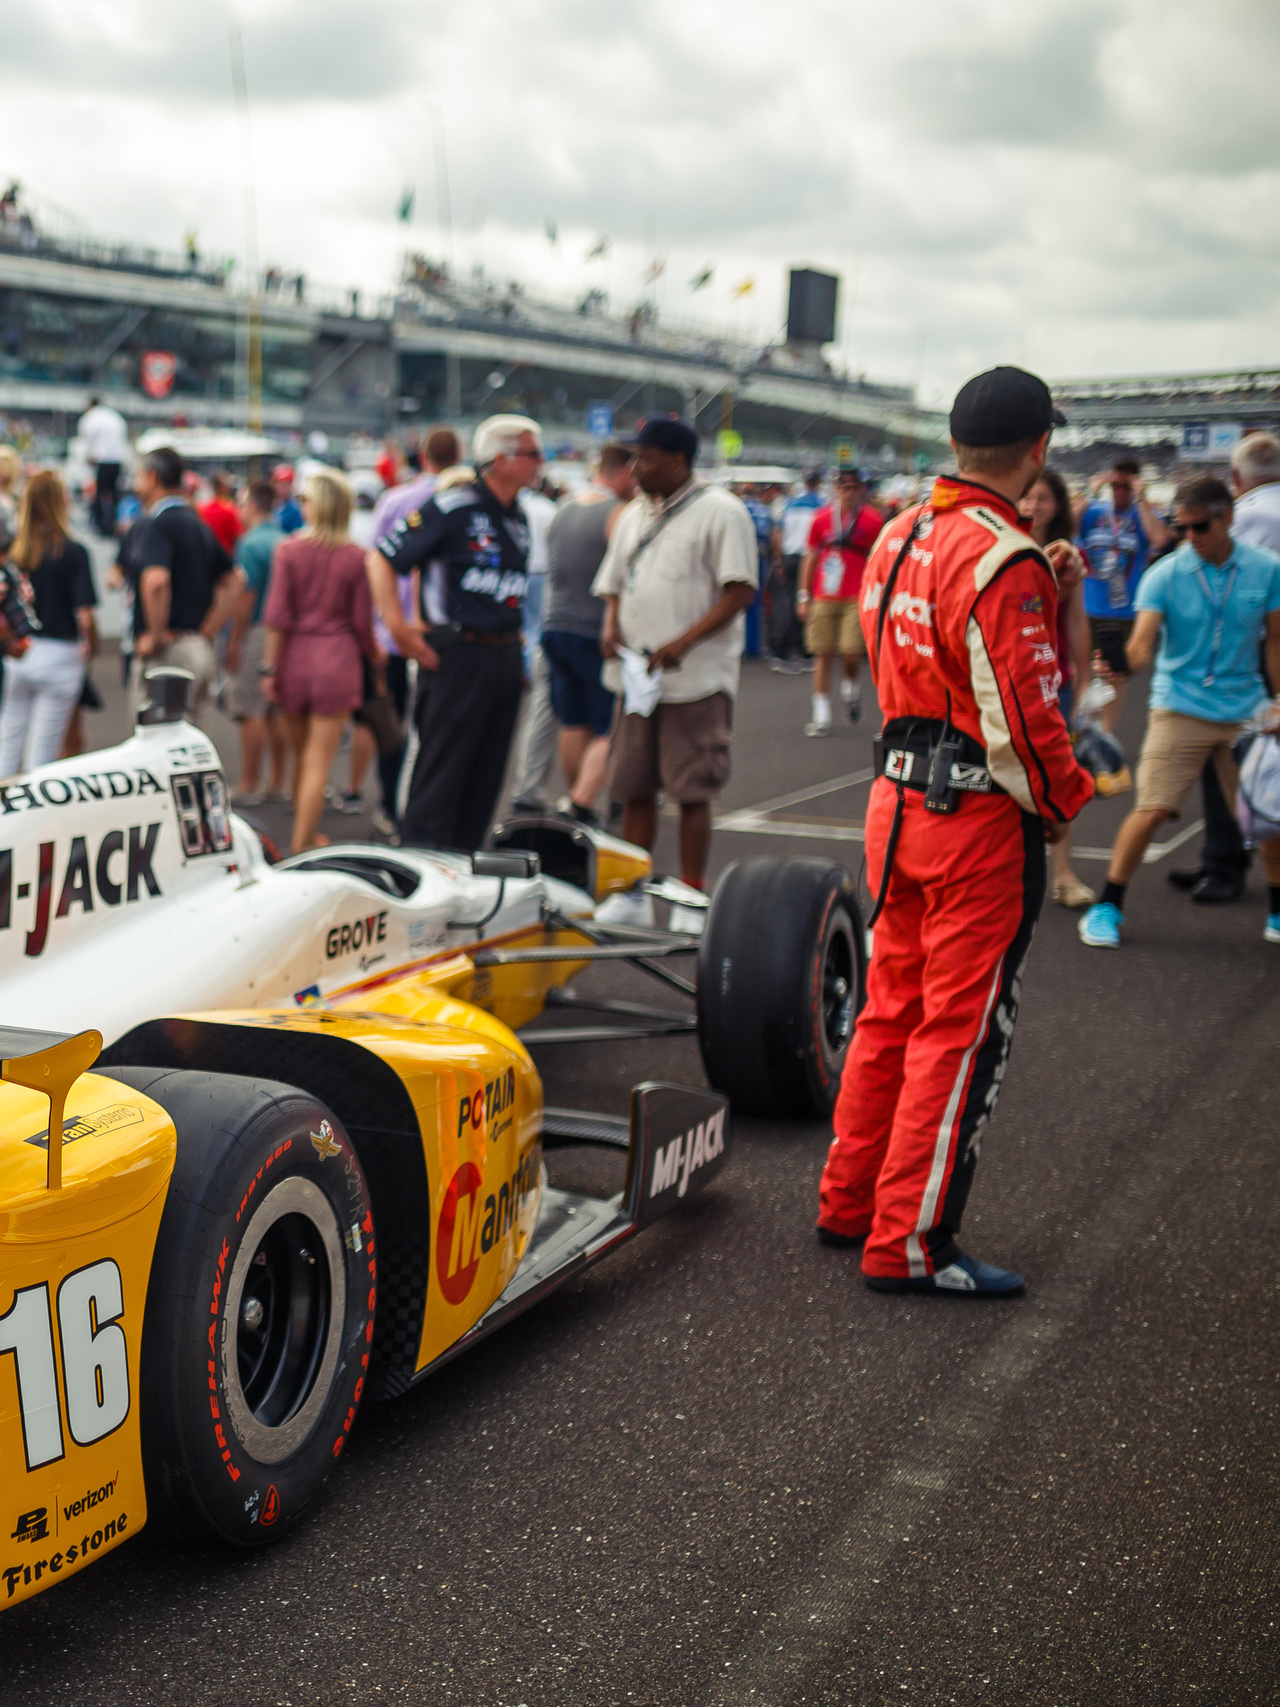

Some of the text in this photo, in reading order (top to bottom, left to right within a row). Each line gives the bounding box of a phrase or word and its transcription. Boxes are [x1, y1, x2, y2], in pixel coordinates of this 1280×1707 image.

[326, 910, 388, 960] GROVE
[236, 1139, 293, 1223] INDY 500
[208, 1236, 242, 1483] FIREHAWK
[332, 1210, 377, 1458] Firestone
[63, 1481, 114, 1521] verizon
[1, 1512, 128, 1599] Firestone
